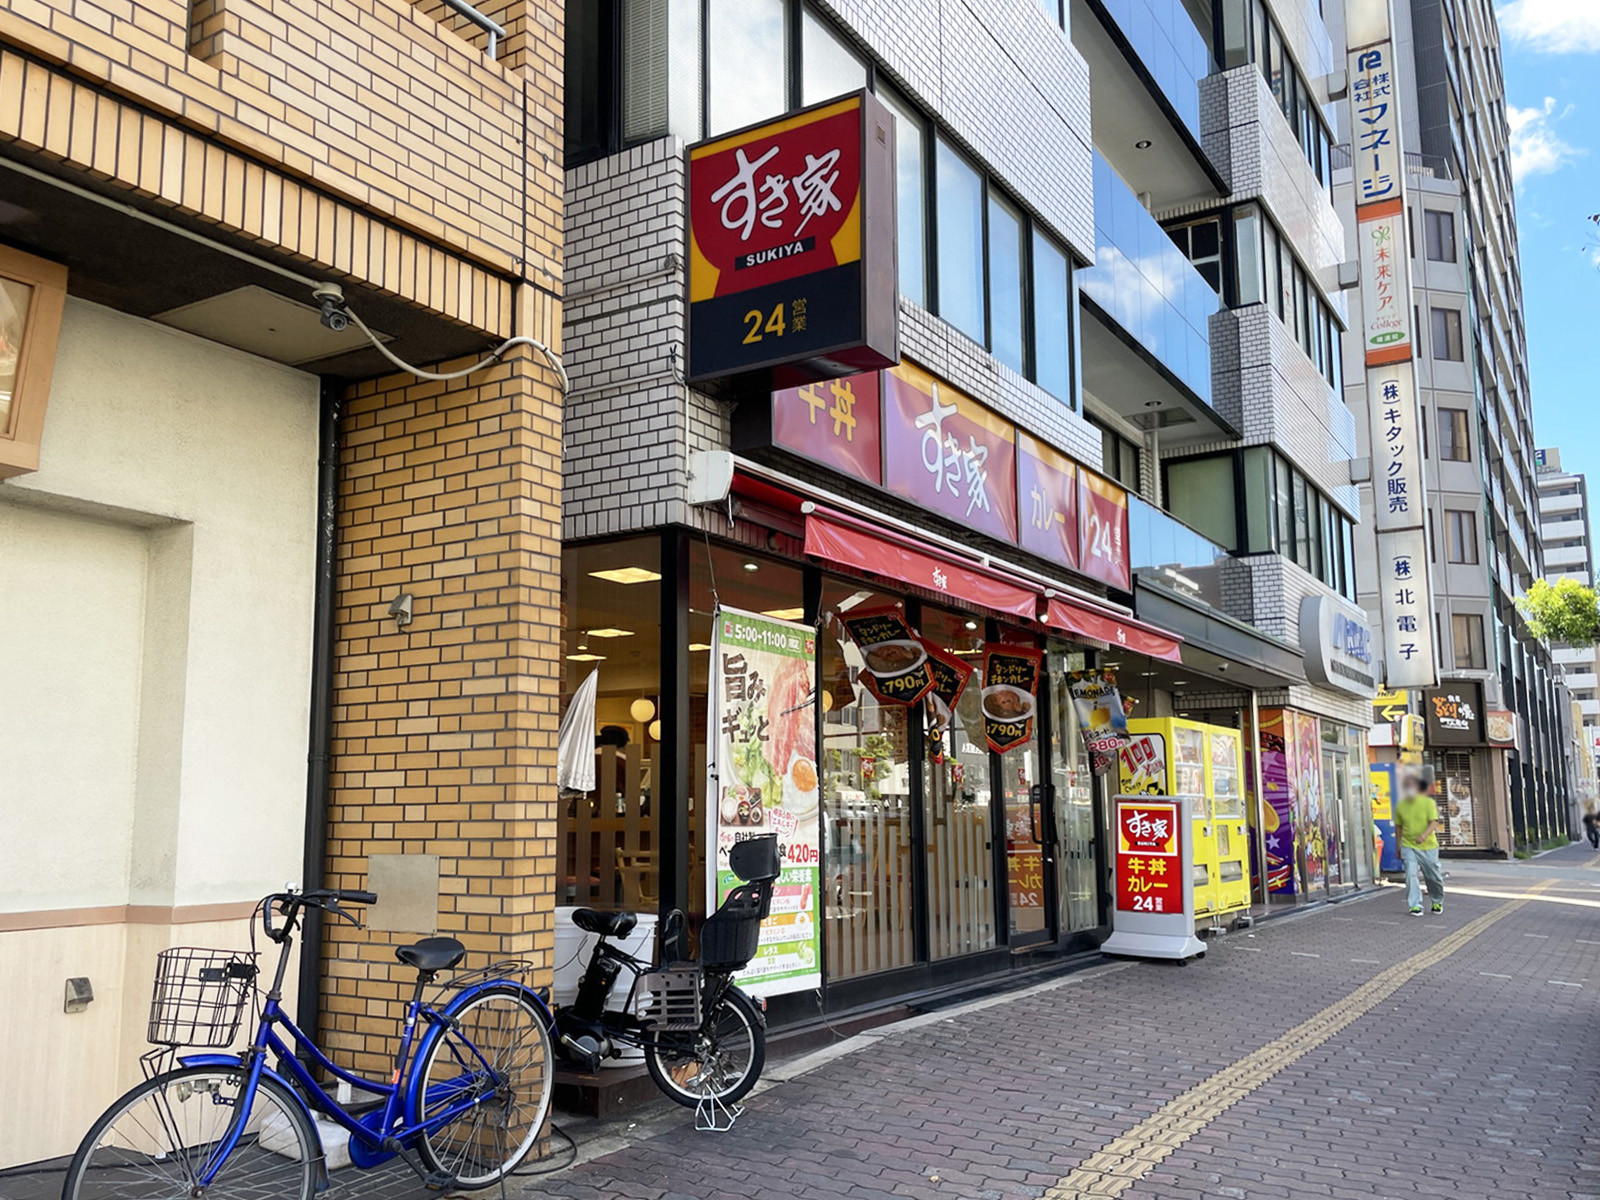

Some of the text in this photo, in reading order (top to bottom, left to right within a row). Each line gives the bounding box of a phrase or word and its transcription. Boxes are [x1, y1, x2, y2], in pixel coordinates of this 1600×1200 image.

[1358, 103, 1393, 198] マネージ
[711, 145, 841, 241] すき家
[745, 241, 804, 267] SUKIYA
[1373, 247, 1393, 312] 未来ケア
[742, 303, 786, 344] 24
[915, 381, 990, 517] すき家
[1030, 484, 1065, 531] カレー
[1090, 514, 1112, 562] 24
[734, 623, 787, 649] 5:00-11:00
[722, 652, 767, 704] 旨み
[722, 706, 770, 744] ギュッと
[1120, 736, 1156, 775] 100
[1126, 810, 1169, 842] すき家
[787, 843, 818, 863] 420円
[1127, 857, 1167, 876] 牛丼
[1127, 875, 1168, 892] カレー
[1133, 895, 1153, 911] 24
